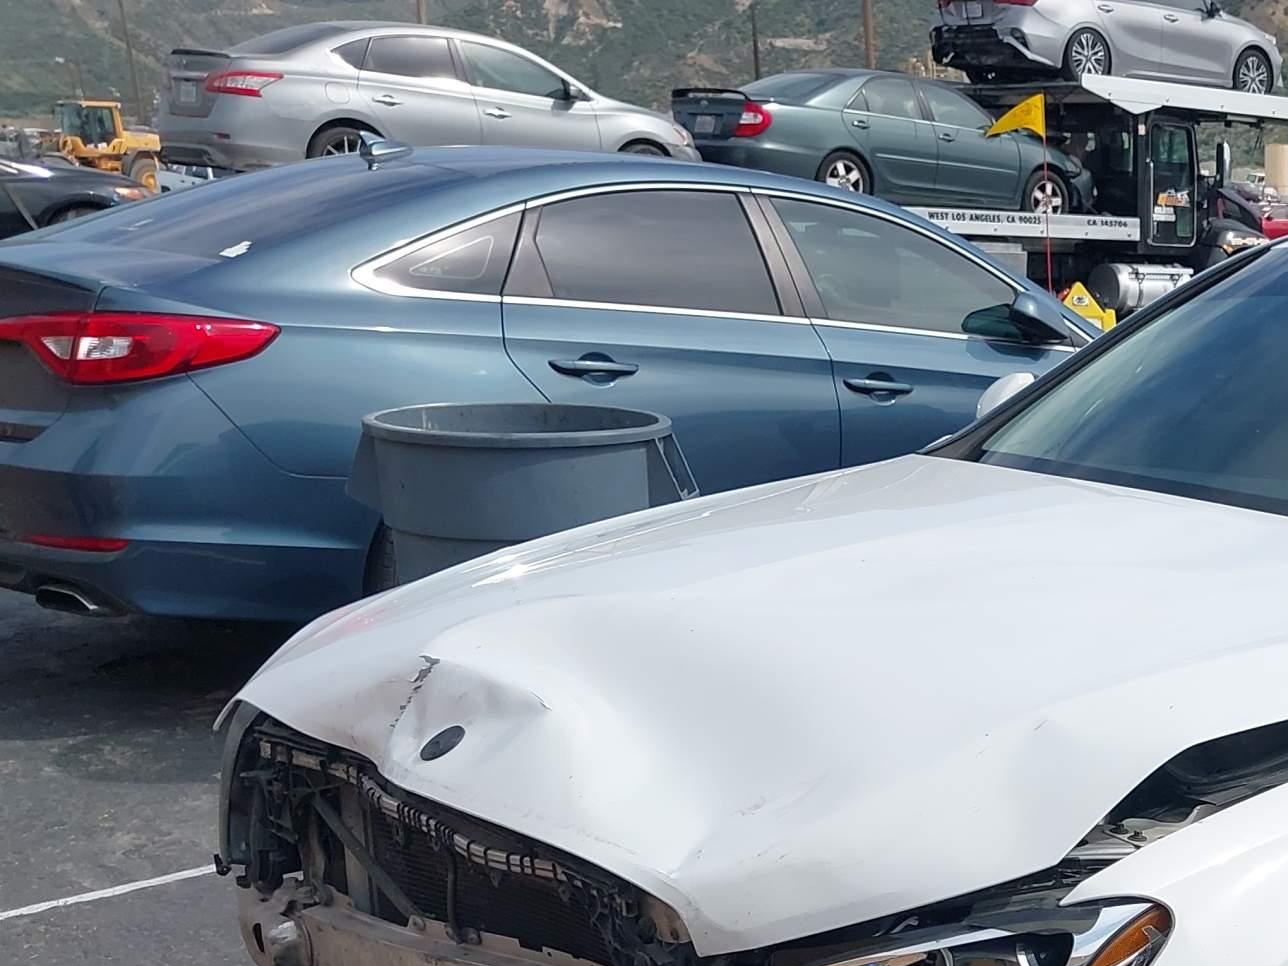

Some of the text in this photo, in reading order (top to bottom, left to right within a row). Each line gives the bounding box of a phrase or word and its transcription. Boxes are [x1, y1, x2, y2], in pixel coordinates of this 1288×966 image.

[928, 211, 949, 221] WEST
[952, 212, 966, 222] LOS
[1006, 215, 1016, 224] CA
[1018, 215, 1042, 225] 90025
